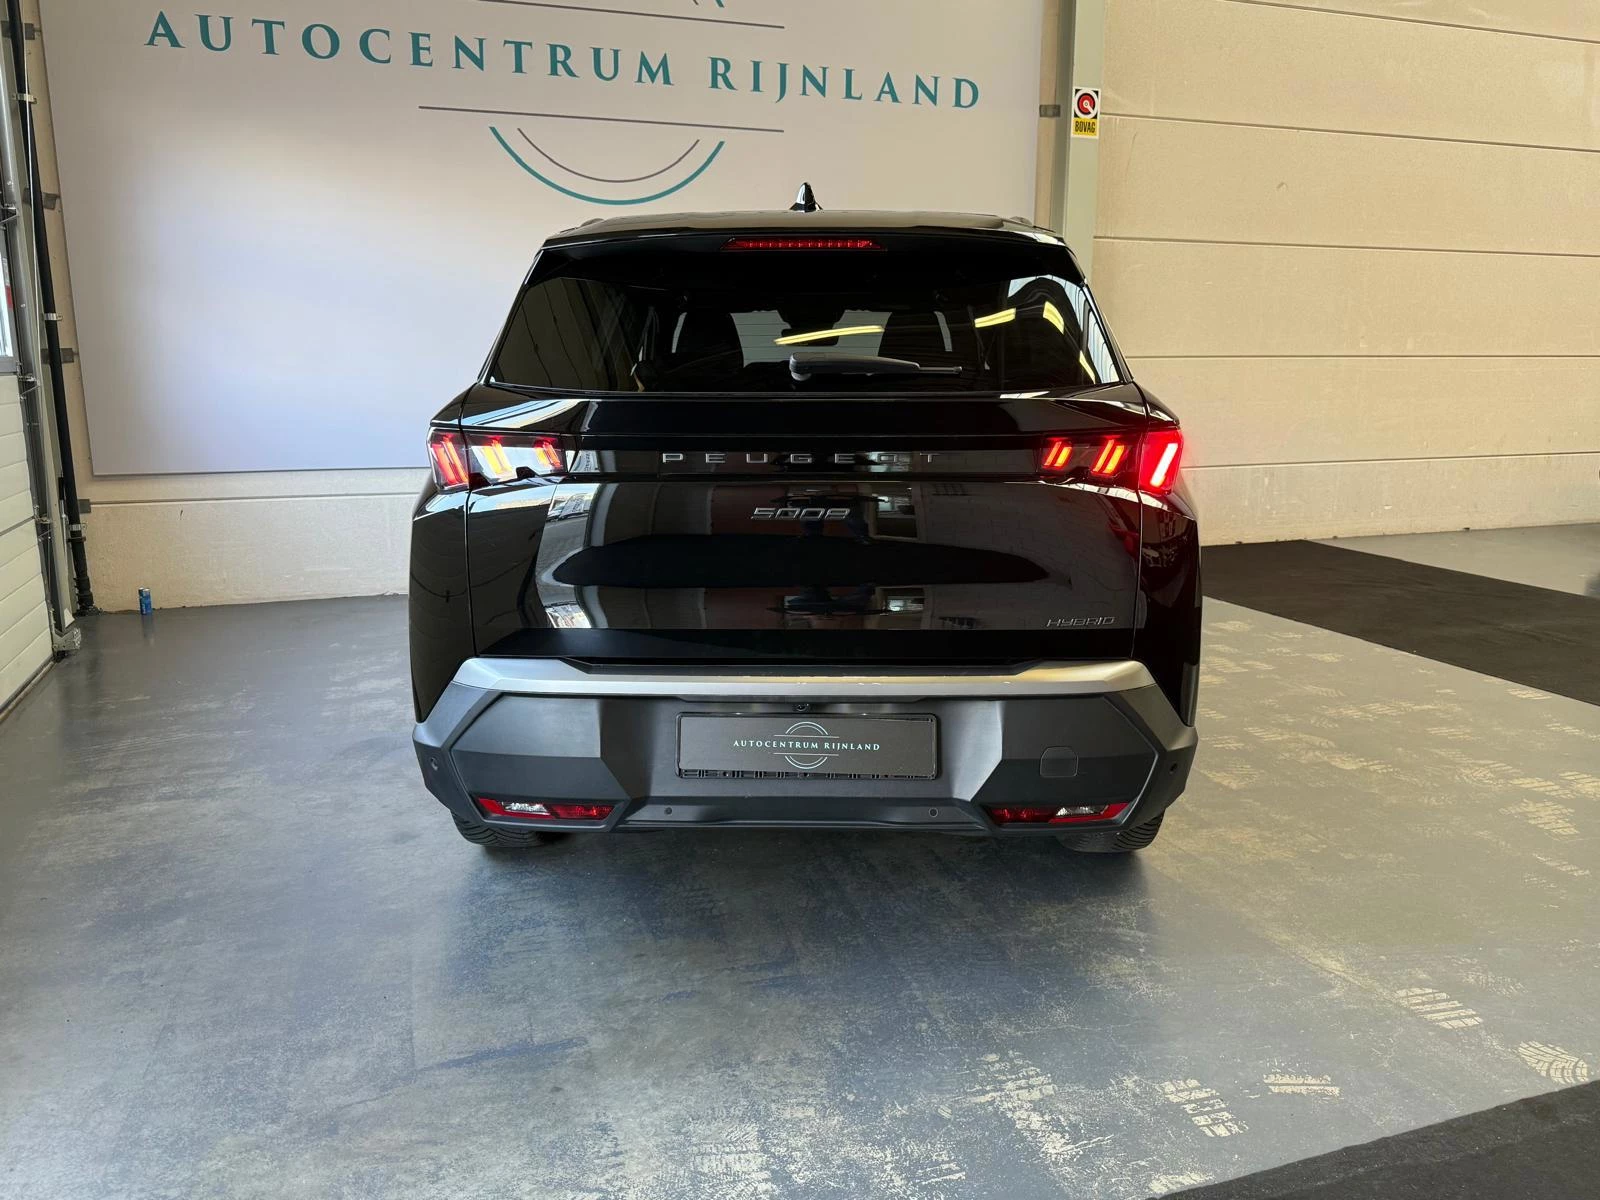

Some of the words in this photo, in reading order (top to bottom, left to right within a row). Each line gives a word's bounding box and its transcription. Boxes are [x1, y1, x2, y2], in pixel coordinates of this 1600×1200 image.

[144, 10, 675, 87] AUTOCENTRUM
[708, 56, 980, 109] RIJNLAND
[1075, 121, 1096, 133] BOVAG
[662, 452, 940, 464] PEUGEOT
[751, 507, 850, 520] 5008
[1046, 616, 1116, 627] HYBRID
[733, 740, 818, 749] AUTOCENTRUM
[824, 743, 881, 751] RIJNLAND
